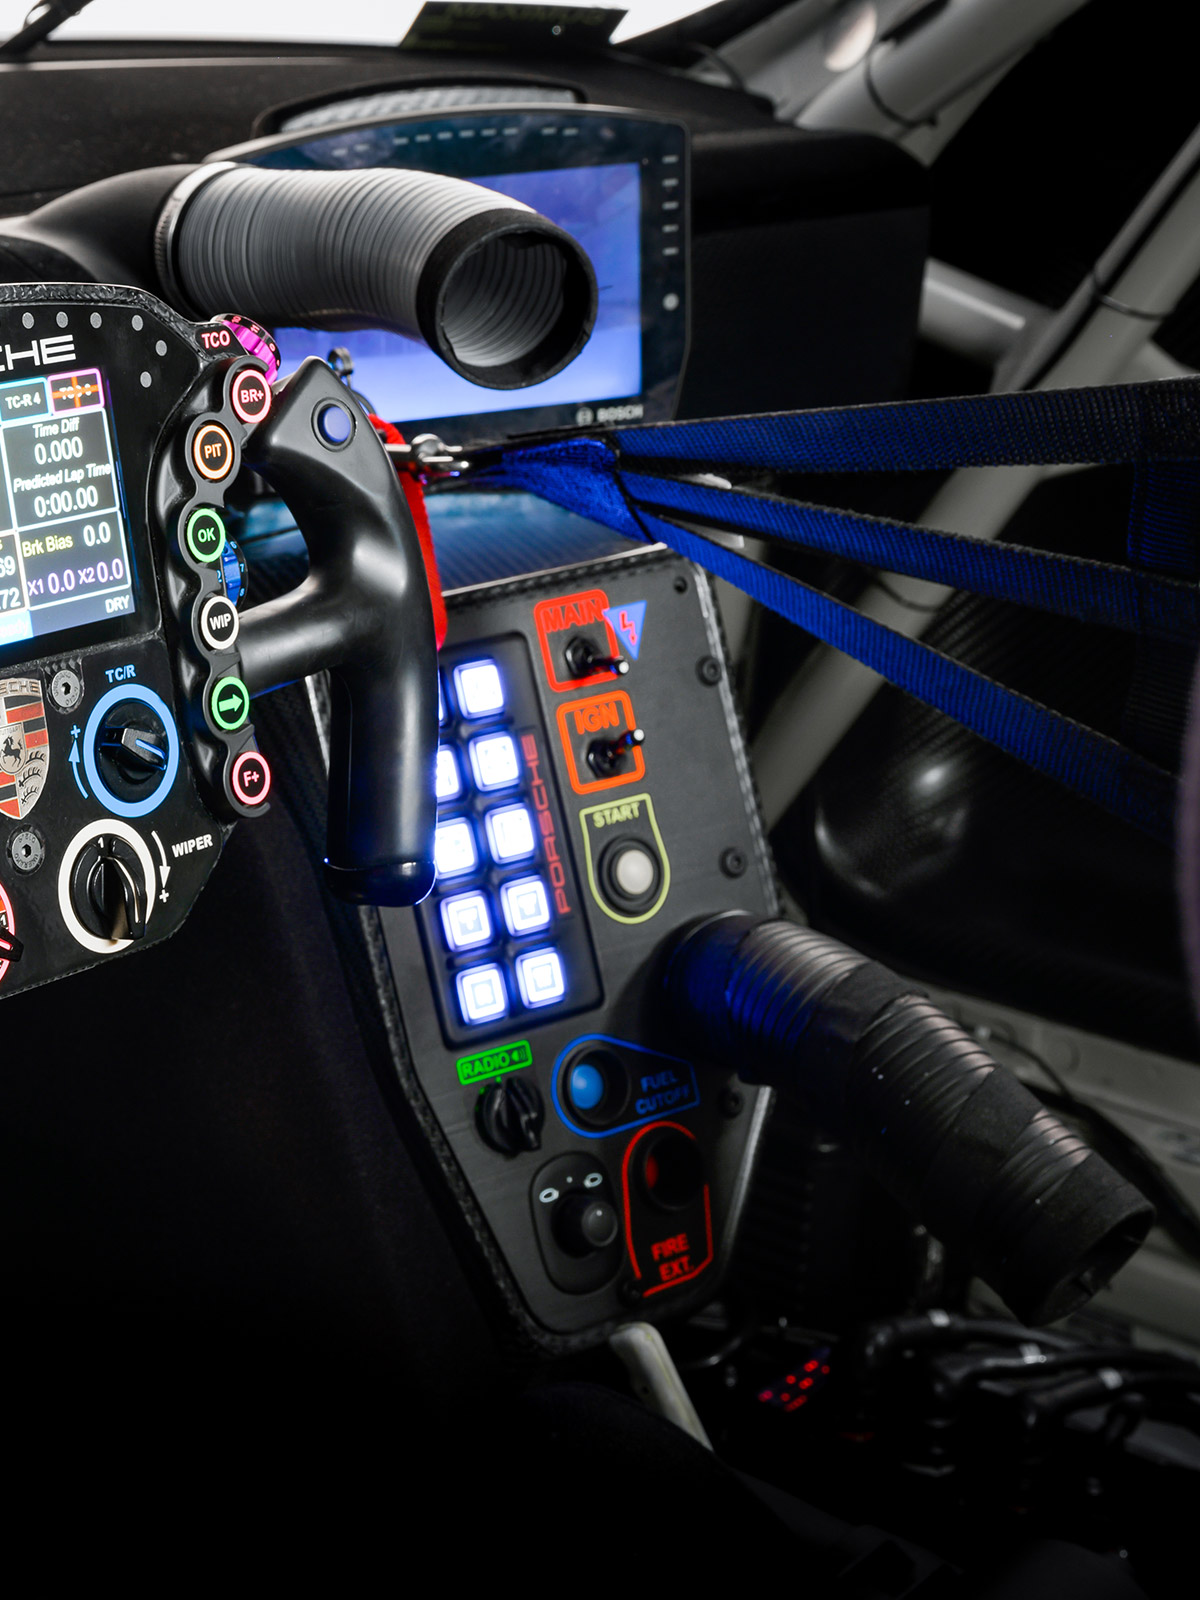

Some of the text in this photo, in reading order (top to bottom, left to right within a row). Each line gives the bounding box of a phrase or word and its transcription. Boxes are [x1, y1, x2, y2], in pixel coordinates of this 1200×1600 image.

[201, 330, 231, 349] TCO
[5, 392, 41, 409] TC-R 4
[240, 388, 264, 404] BR+
[597, 404, 644, 422] BOSCH
[32, 417, 80, 438] Time Diff
[34, 436, 83, 465] 0.000
[204, 442, 222, 459] PIT
[13, 463, 111, 493] Predicted Lap Time
[34, 485, 98, 518] 0:00.00
[22, 521, 111, 557] Brk Bias 0.0
[197, 528, 217, 543] OK
[27, 558, 123, 596] X1 0.0 X2 0.0
[104, 595, 129, 613] DRY
[542, 600, 603, 633] MAIN
[209, 613, 231, 631] WIP
[105, 664, 136, 683] TC/R
[573, 702, 619, 735] IGN
[242, 770, 260, 787] F+
[521, 734, 571, 915] PORSCHE
[593, 802, 640, 828] START
[171, 834, 213, 858] WIPER
[462, 1051, 510, 1078] RADIO
[641, 1070, 679, 1092] FUEL
[635, 1084, 690, 1115] CUTOFF
[651, 1233, 689, 1261] FIRE
[659, 1255, 695, 1282] EXT.
